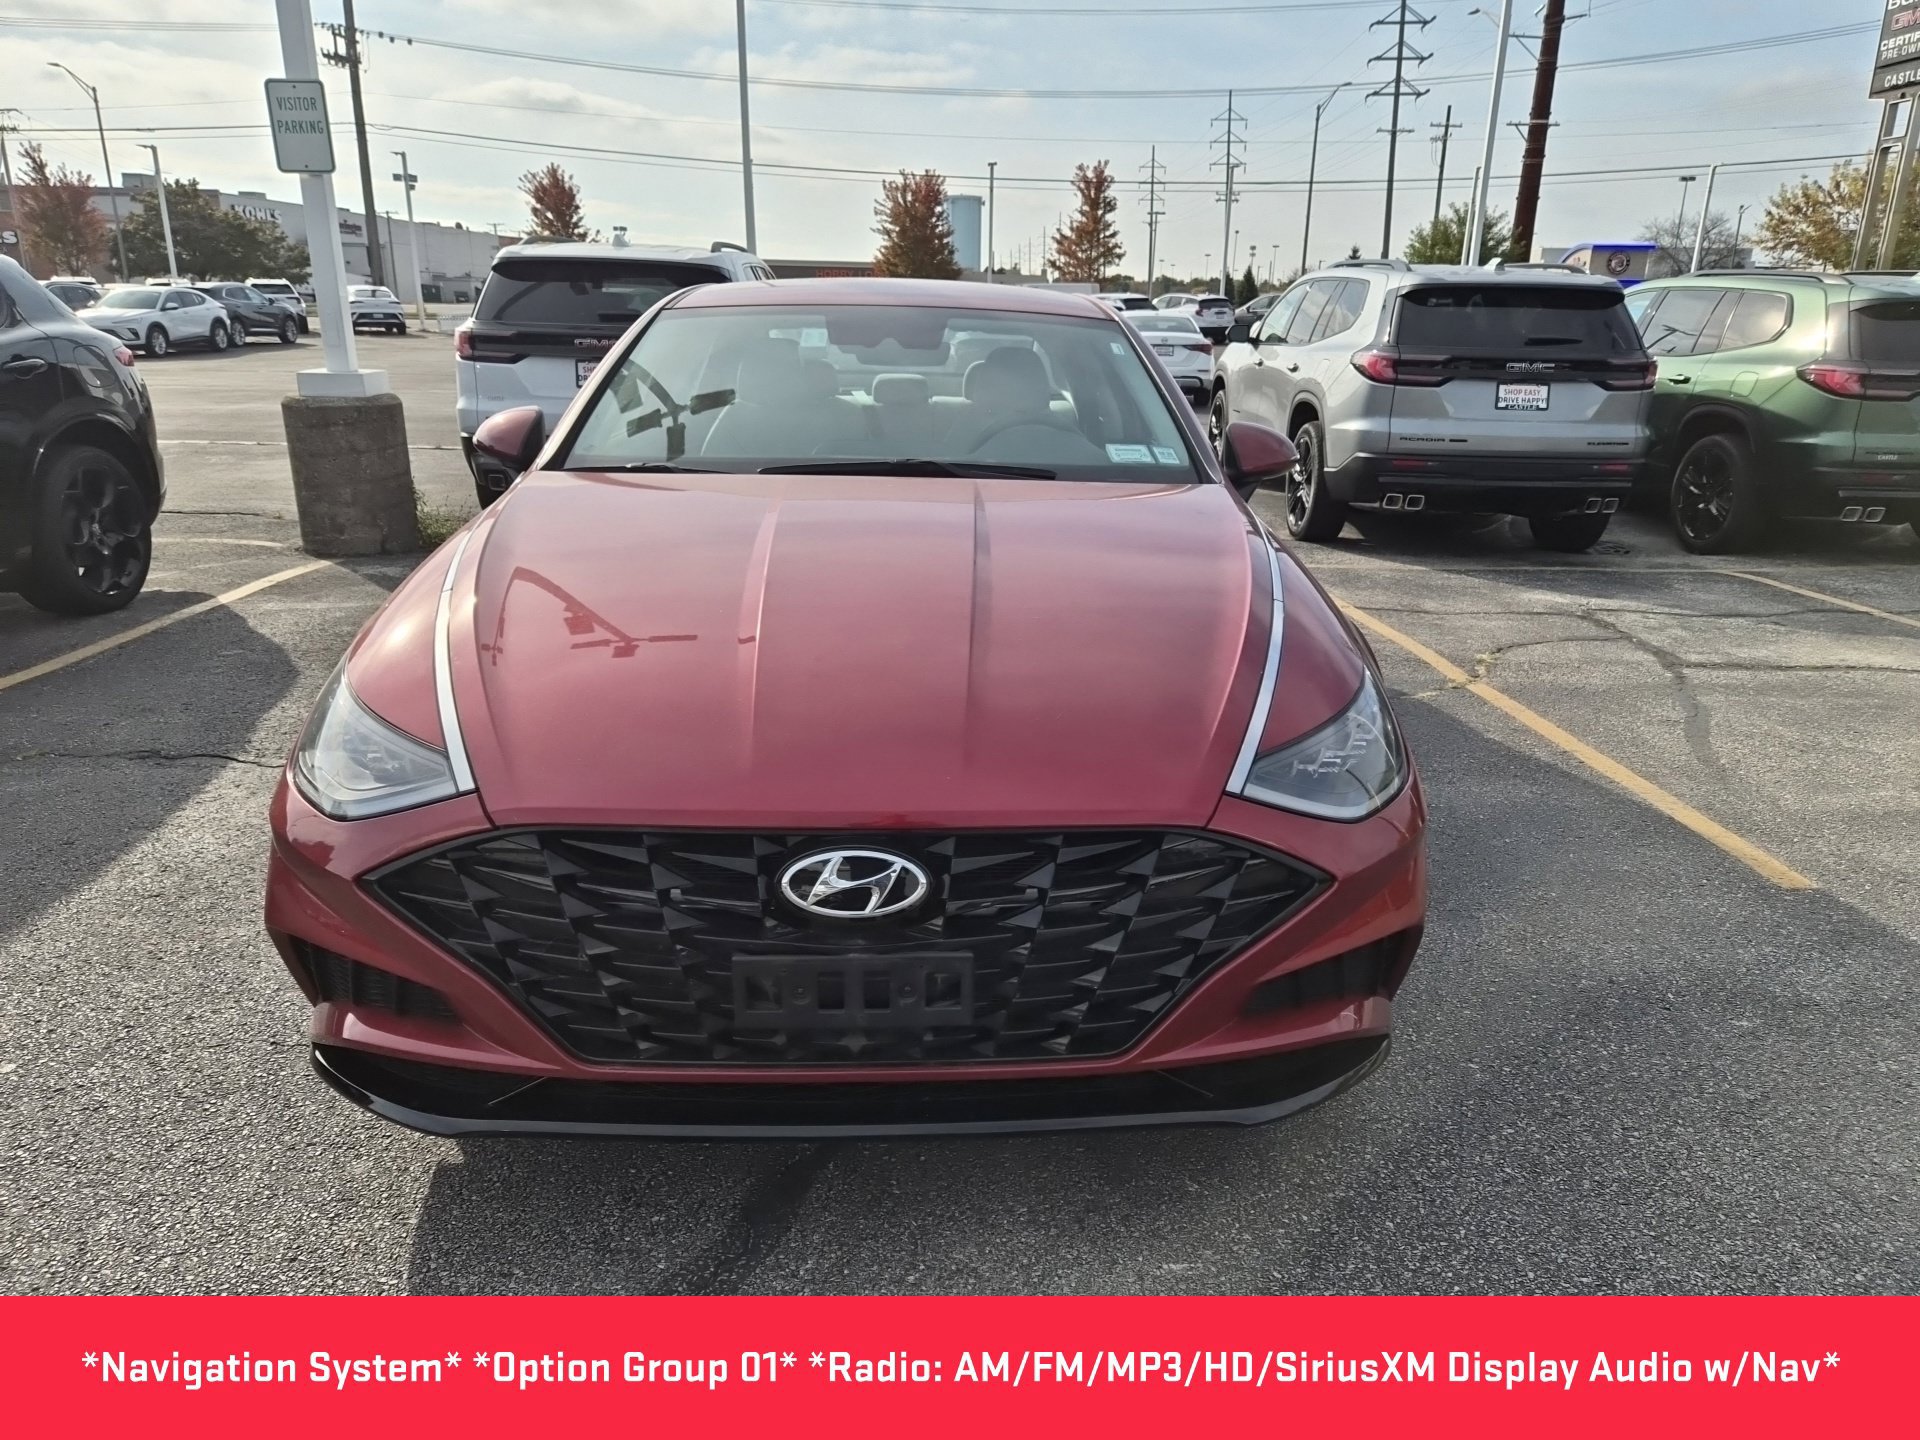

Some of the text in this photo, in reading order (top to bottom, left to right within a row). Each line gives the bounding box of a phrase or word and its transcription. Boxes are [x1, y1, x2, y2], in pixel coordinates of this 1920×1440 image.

[276, 96, 318, 112] VISITOR
[277, 119, 324, 135] PARKING
[1506, 362, 1555, 373] GMC
[1504, 388, 1523, 396] SHOP
[1498, 396, 1520, 404] DRIVE
